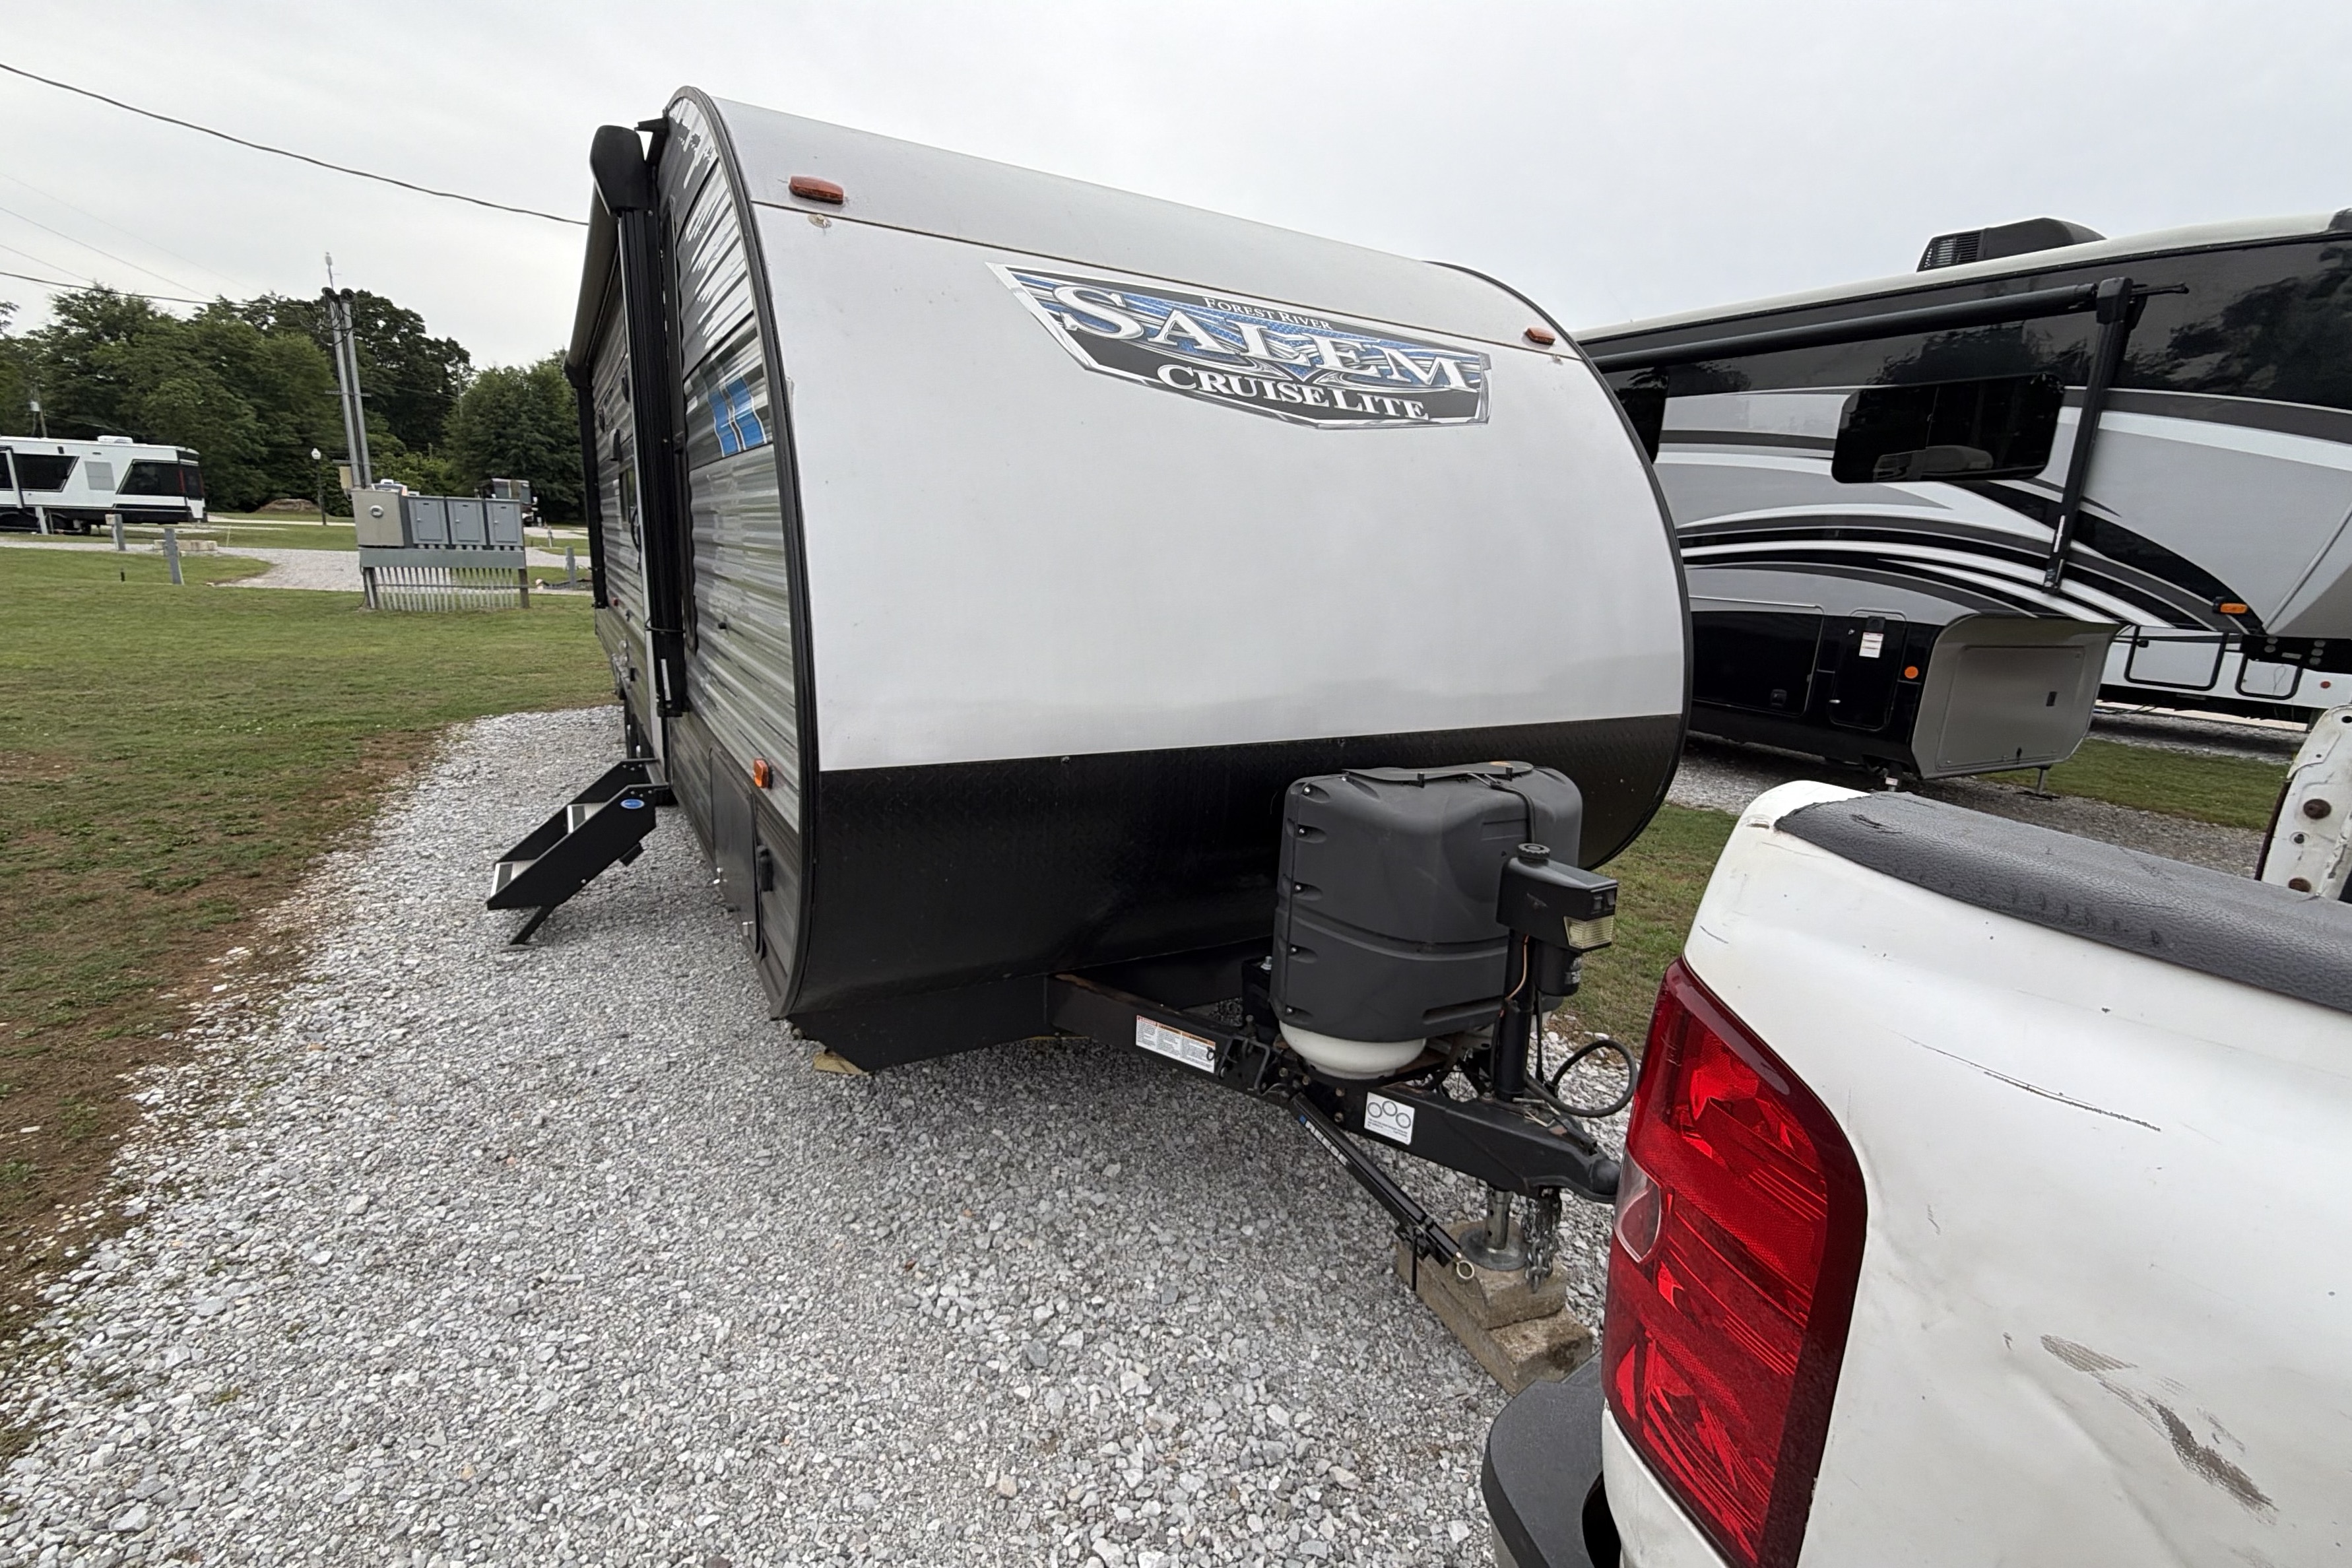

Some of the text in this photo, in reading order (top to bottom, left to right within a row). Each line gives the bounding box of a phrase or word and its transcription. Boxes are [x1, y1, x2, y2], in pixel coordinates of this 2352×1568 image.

[1053, 285, 1478, 393] SALEM
[1203, 297, 1333, 330] FOREST RIVER
